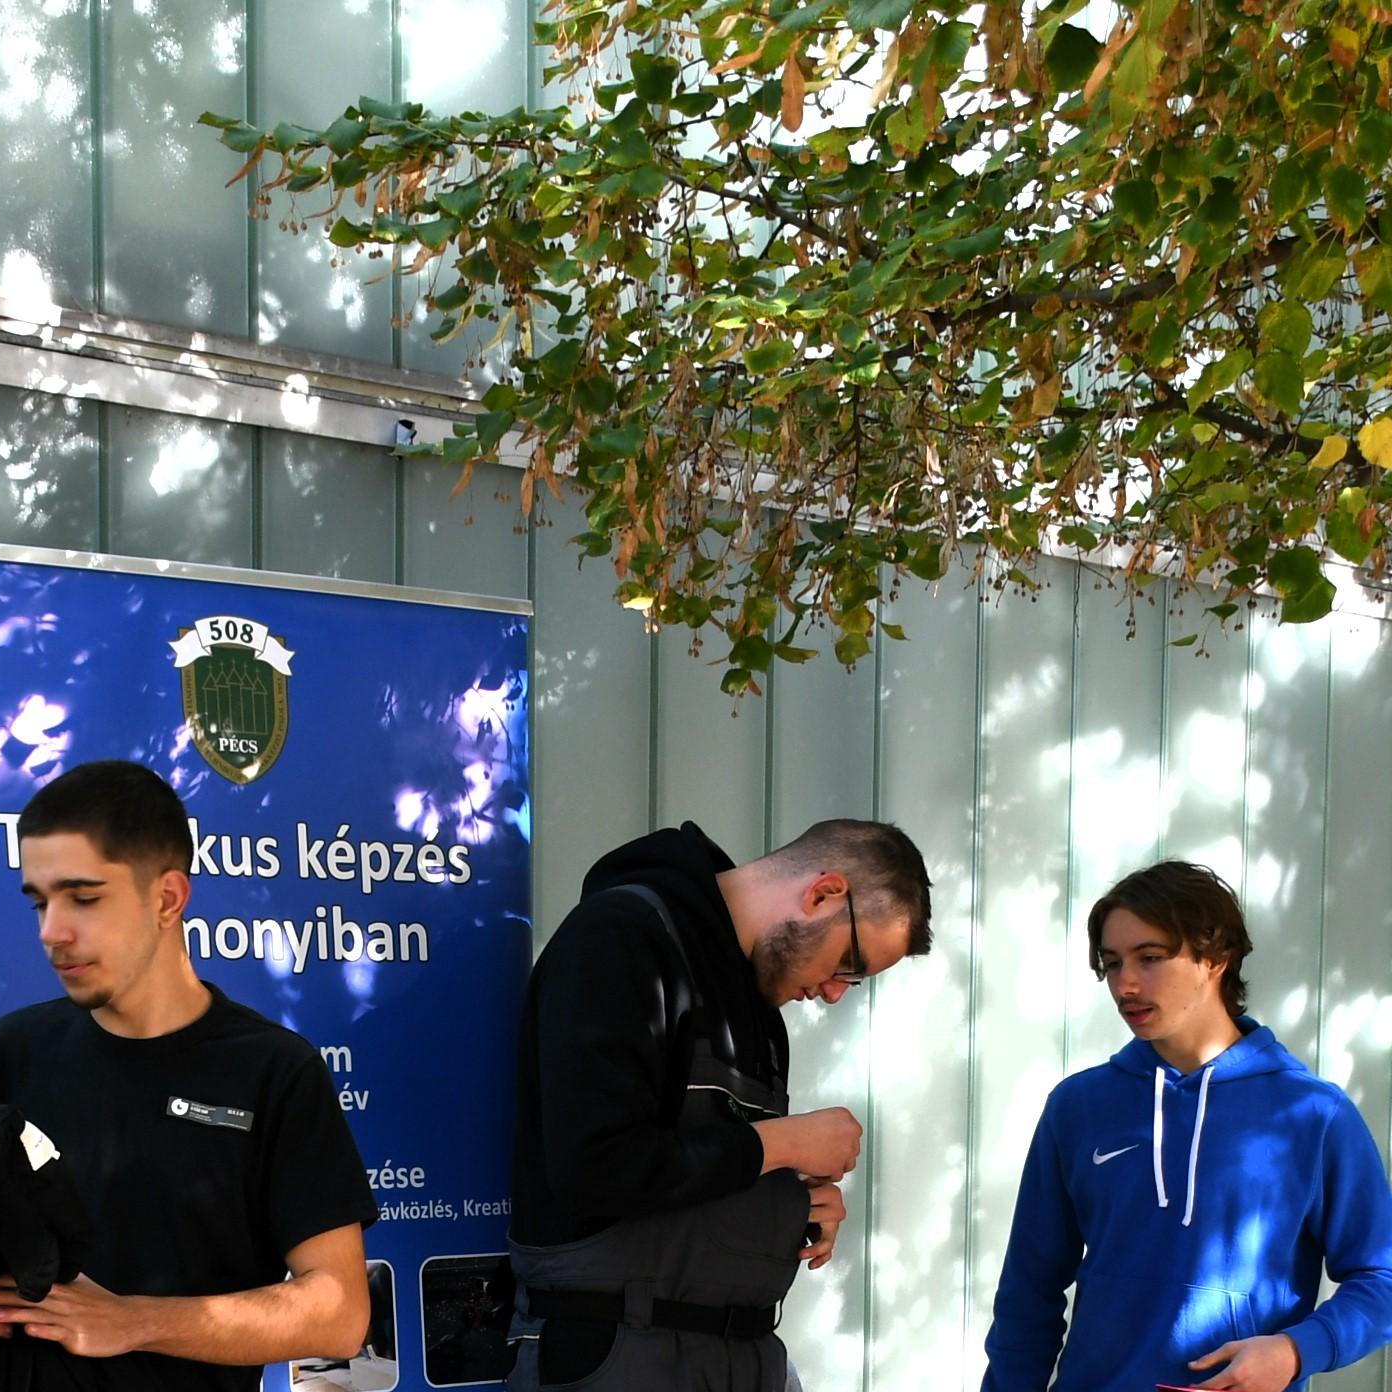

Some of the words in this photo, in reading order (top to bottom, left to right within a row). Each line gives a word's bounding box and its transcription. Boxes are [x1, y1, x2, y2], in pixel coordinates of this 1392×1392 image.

[296, 822, 472, 894] képzés
[184, 905, 429, 973] onyiban
[366, 1160, 425, 1190] zése
[377, 1200, 458, 1221] ávközlés,
